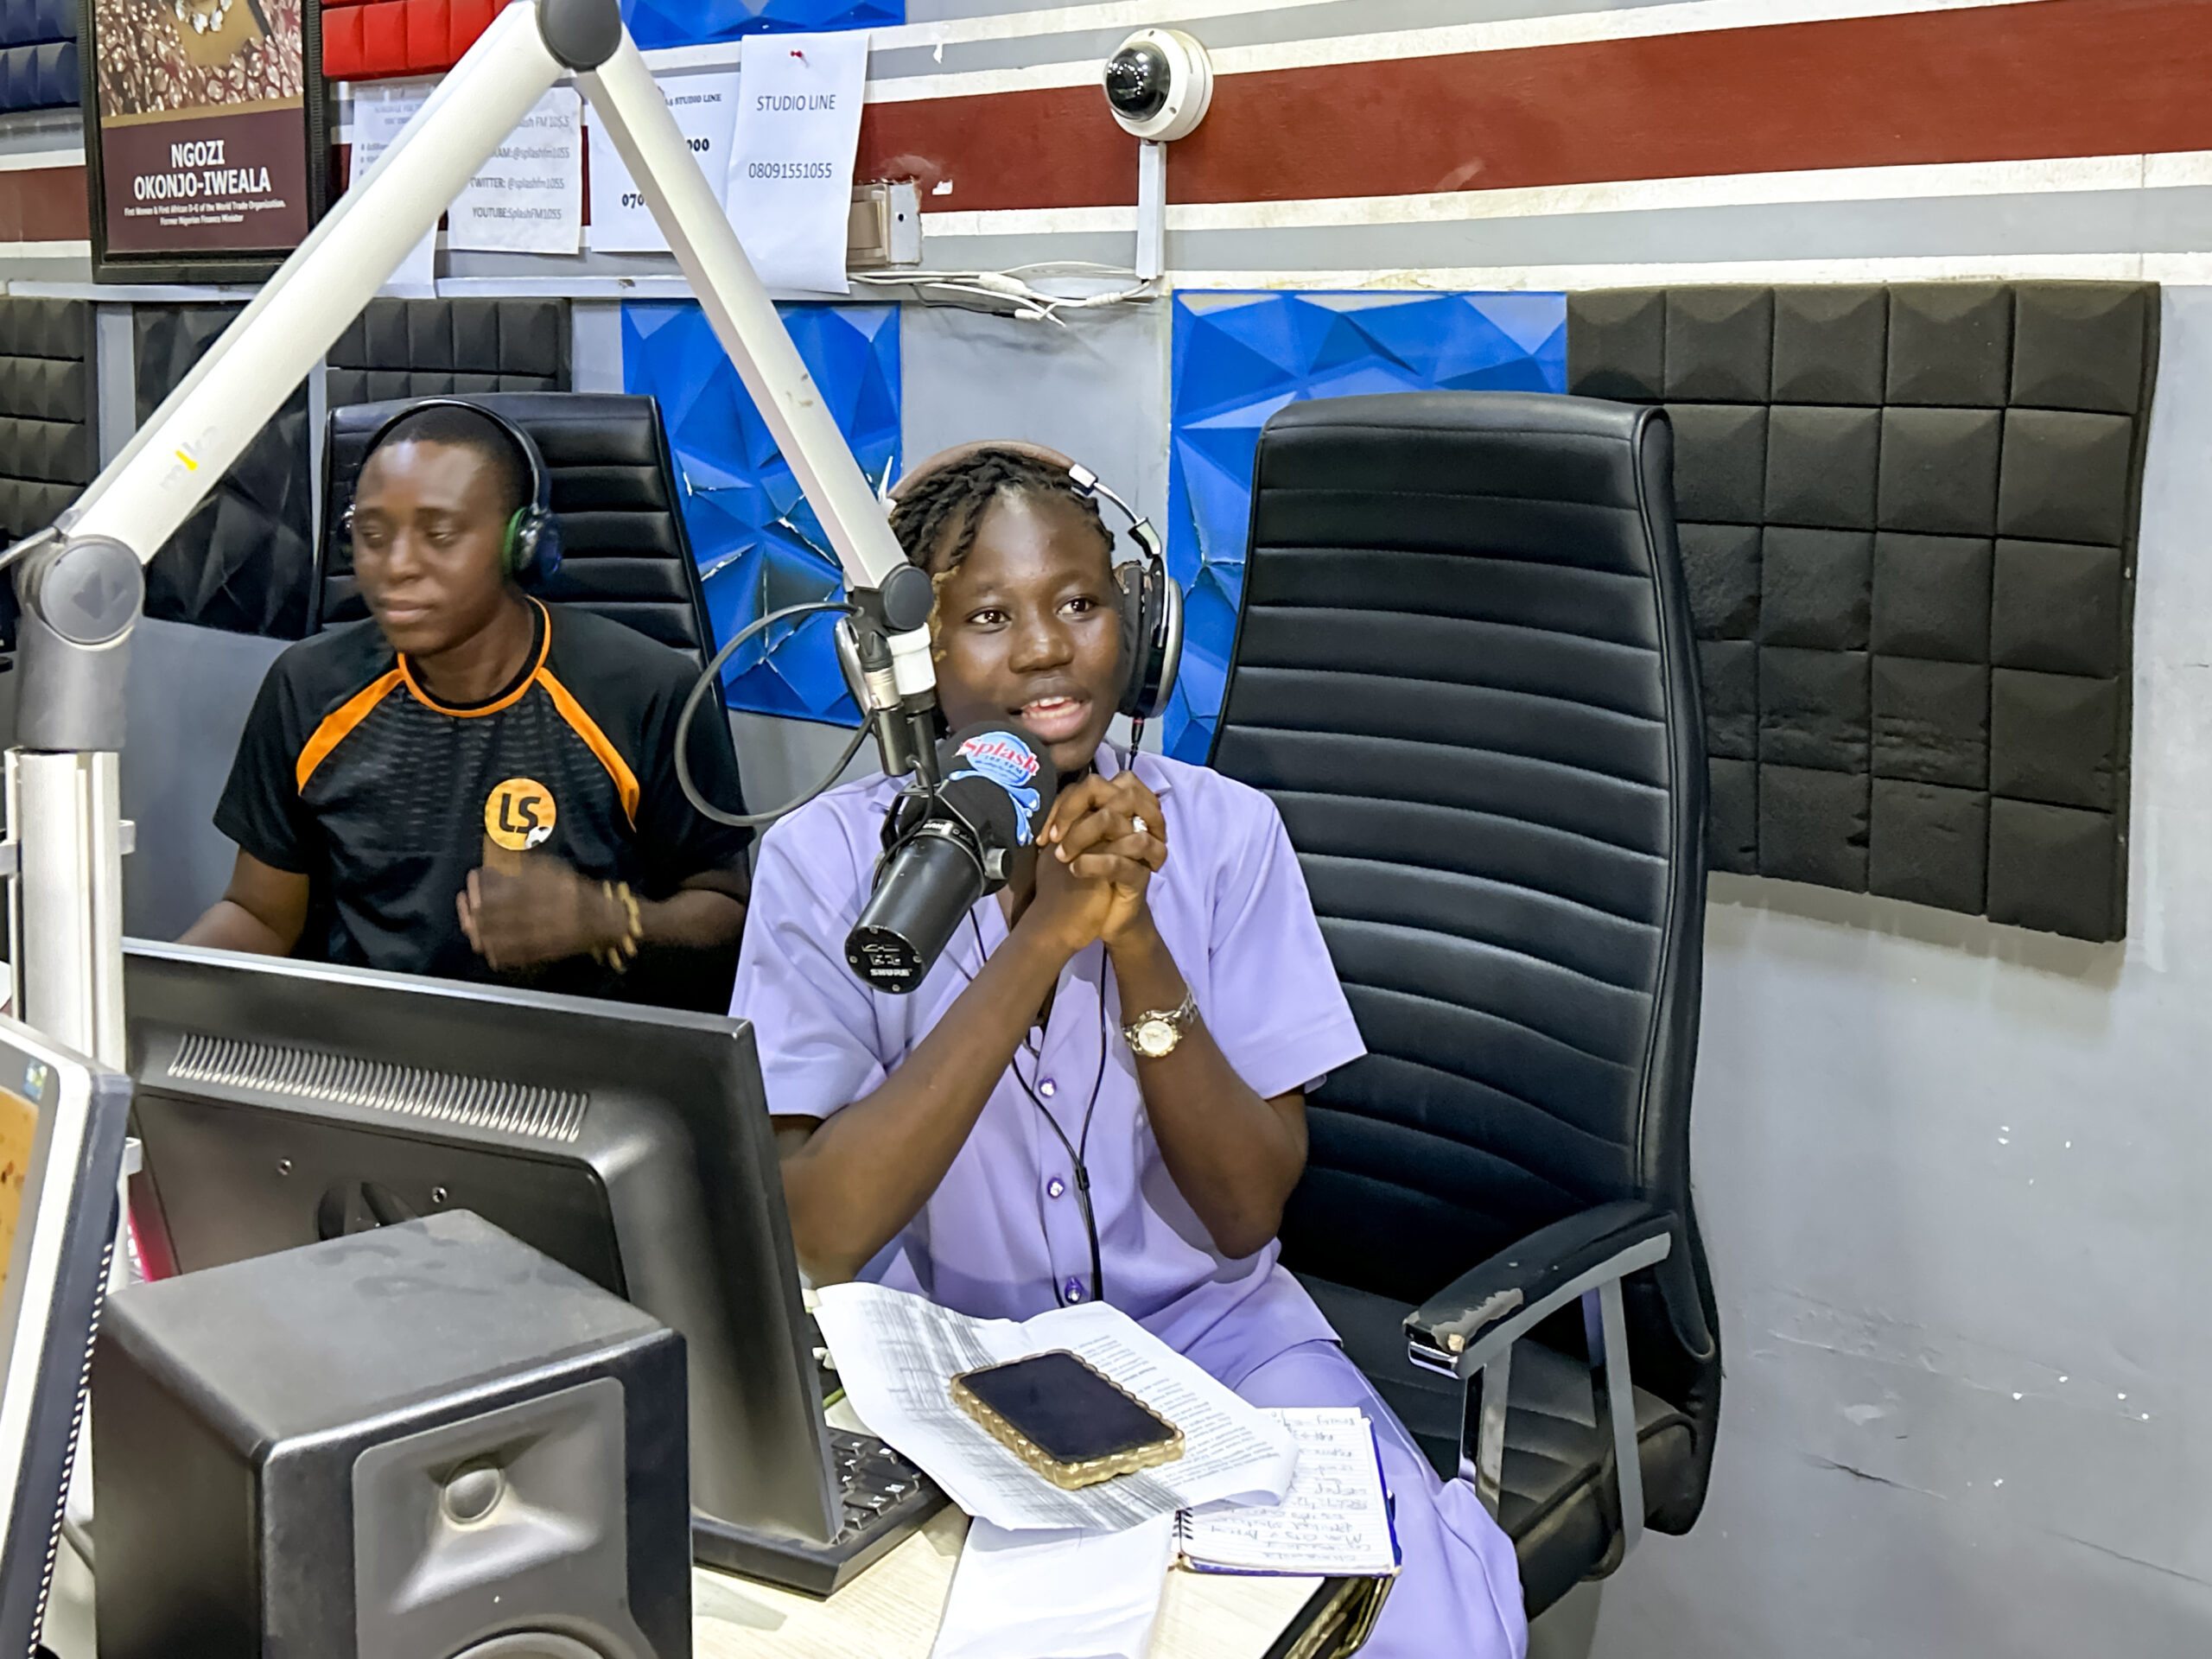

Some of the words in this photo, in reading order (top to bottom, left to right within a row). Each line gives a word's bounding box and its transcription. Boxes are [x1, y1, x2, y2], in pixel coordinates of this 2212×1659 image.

[674, 95, 702, 105] STUDIO
[703, 93, 721, 103] LINE
[756, 95, 806, 111] STUDIO
[809, 94, 836, 111] LINE
[170, 140, 226, 168] NGOZI
[134, 167, 272, 200] OKONJO-IWEALA
[748, 162, 832, 179] 08091551055
[963, 741, 1039, 775] Splash
[499, 792, 542, 835] LS
